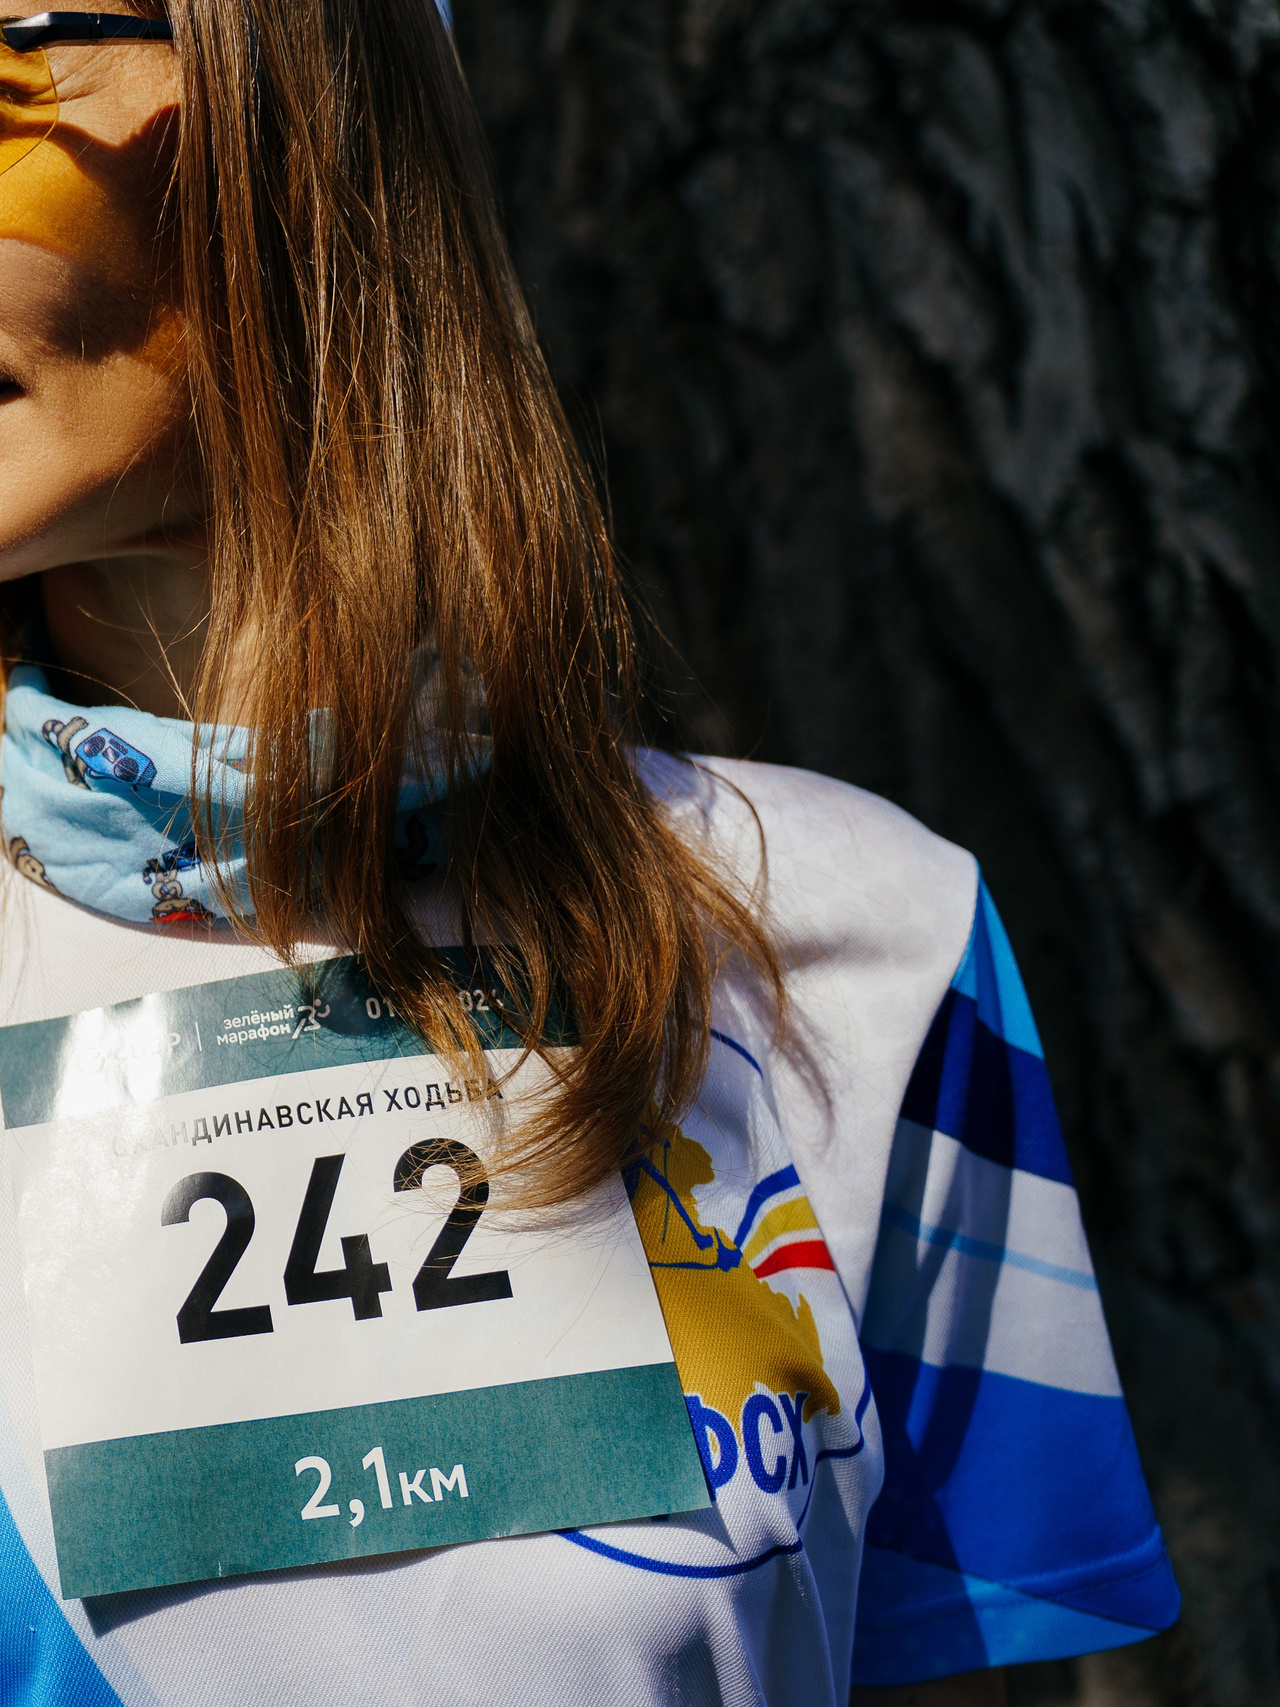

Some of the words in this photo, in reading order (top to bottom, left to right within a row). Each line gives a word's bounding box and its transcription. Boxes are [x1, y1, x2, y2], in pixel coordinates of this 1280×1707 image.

[216, 1023, 291, 1045] марафон
[223, 1004, 294, 1030] зелёный
[160, 1137, 514, 1344] 242
[294, 1446, 469, 1528] 2,1км
